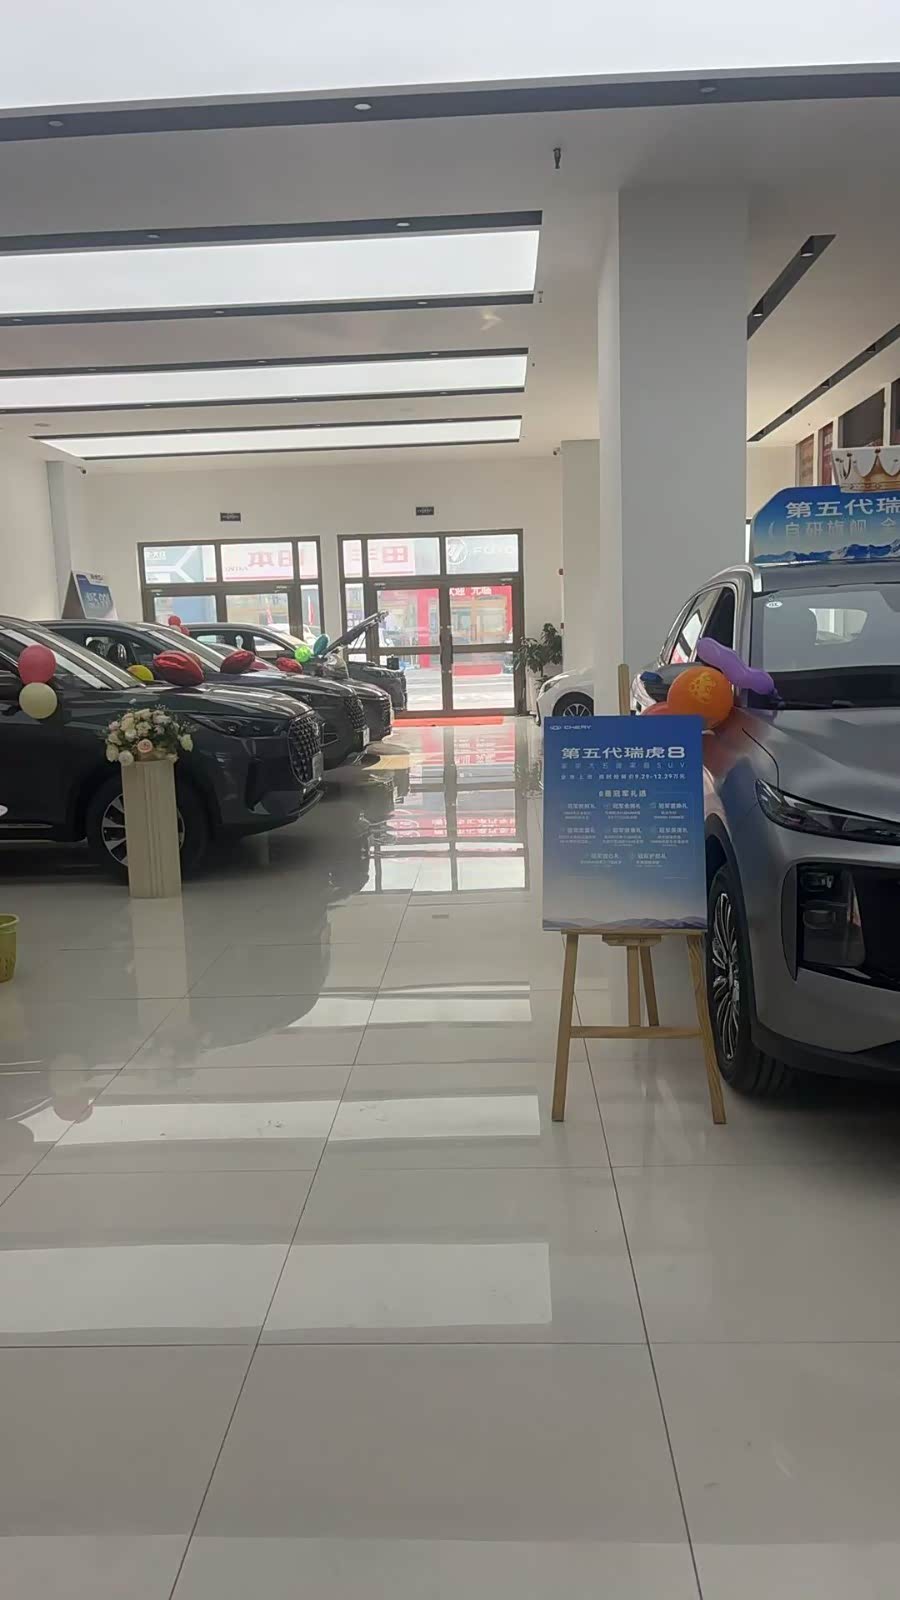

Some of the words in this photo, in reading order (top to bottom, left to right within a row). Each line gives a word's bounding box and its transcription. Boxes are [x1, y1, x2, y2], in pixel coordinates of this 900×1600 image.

[785, 498, 900, 519] 第五代瑞
[561, 746, 686, 759] 第五代瑞虎8
